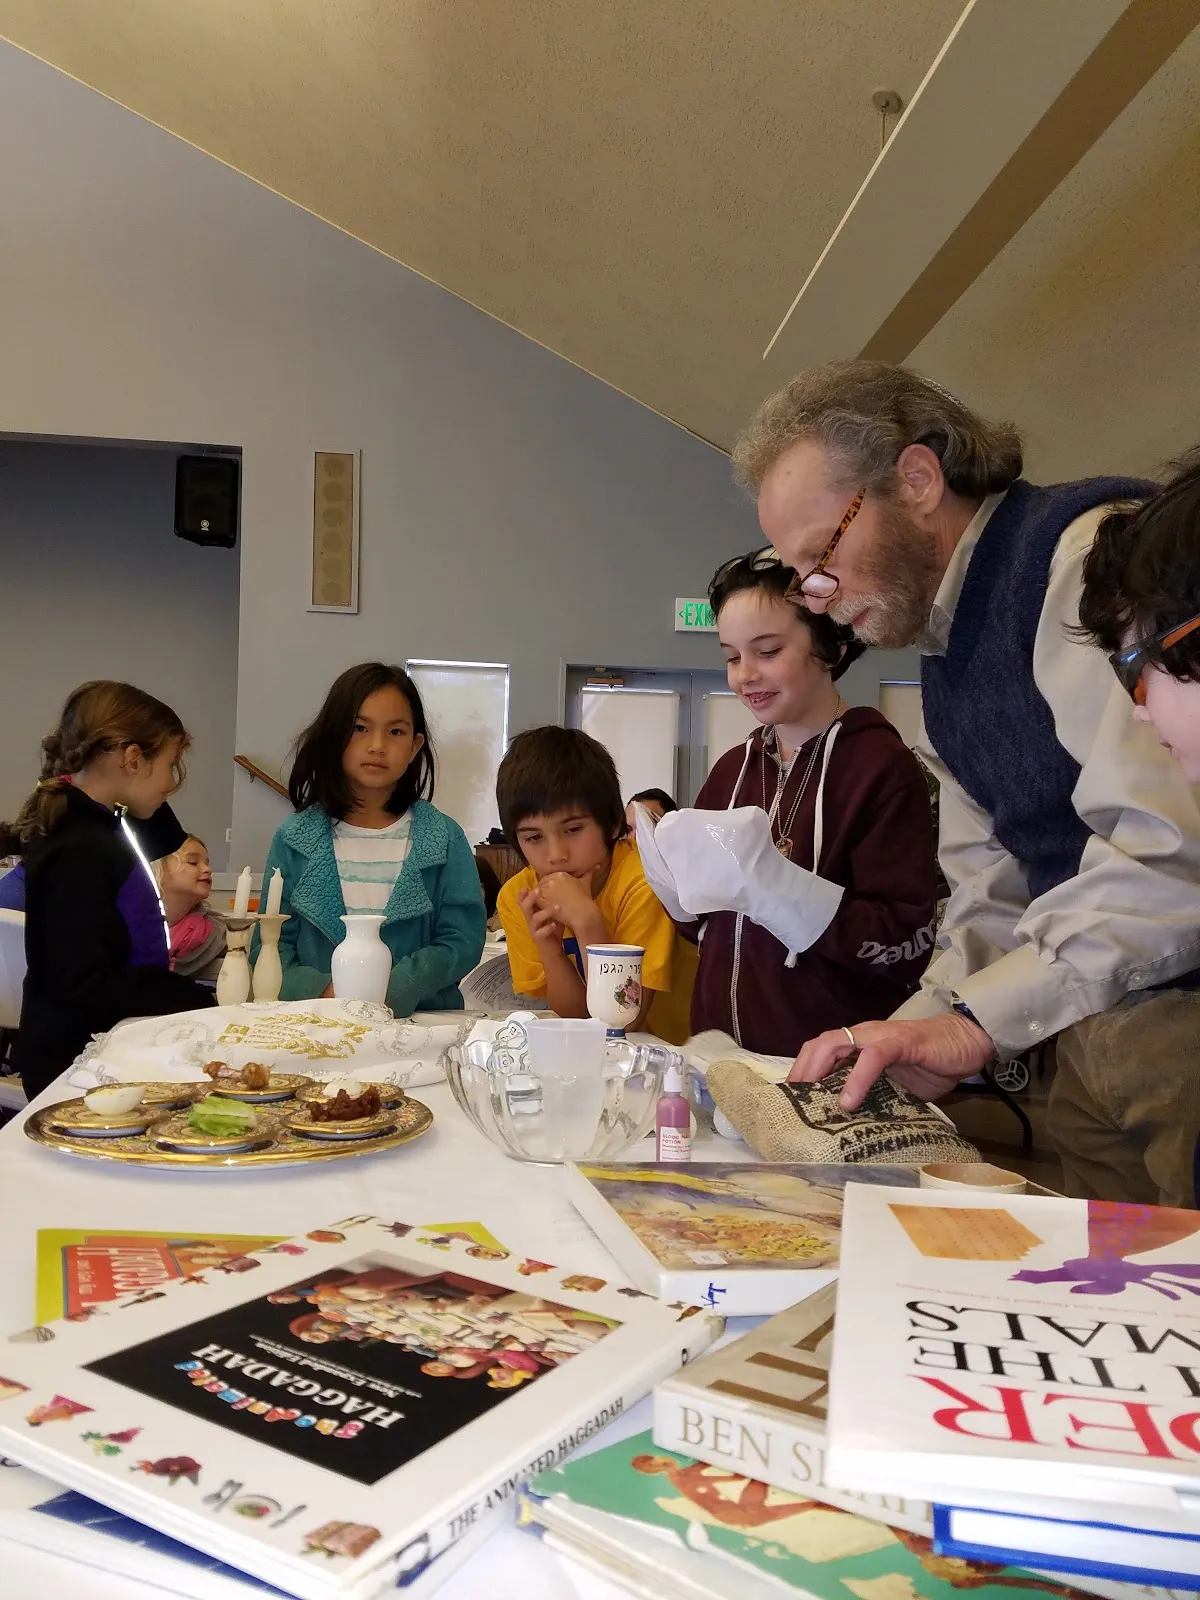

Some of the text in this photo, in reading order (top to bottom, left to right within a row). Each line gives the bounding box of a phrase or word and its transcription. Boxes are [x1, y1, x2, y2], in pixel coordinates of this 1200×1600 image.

[599, 962, 624, 975] הגפן
[191, 1343, 405, 1429] HAGGADAH
[905, 1335, 1148, 1394] THE
[448, 1396, 624, 1541] THE ANIMTED HAGGADAH
[678, 1406, 772, 1470] BEN
